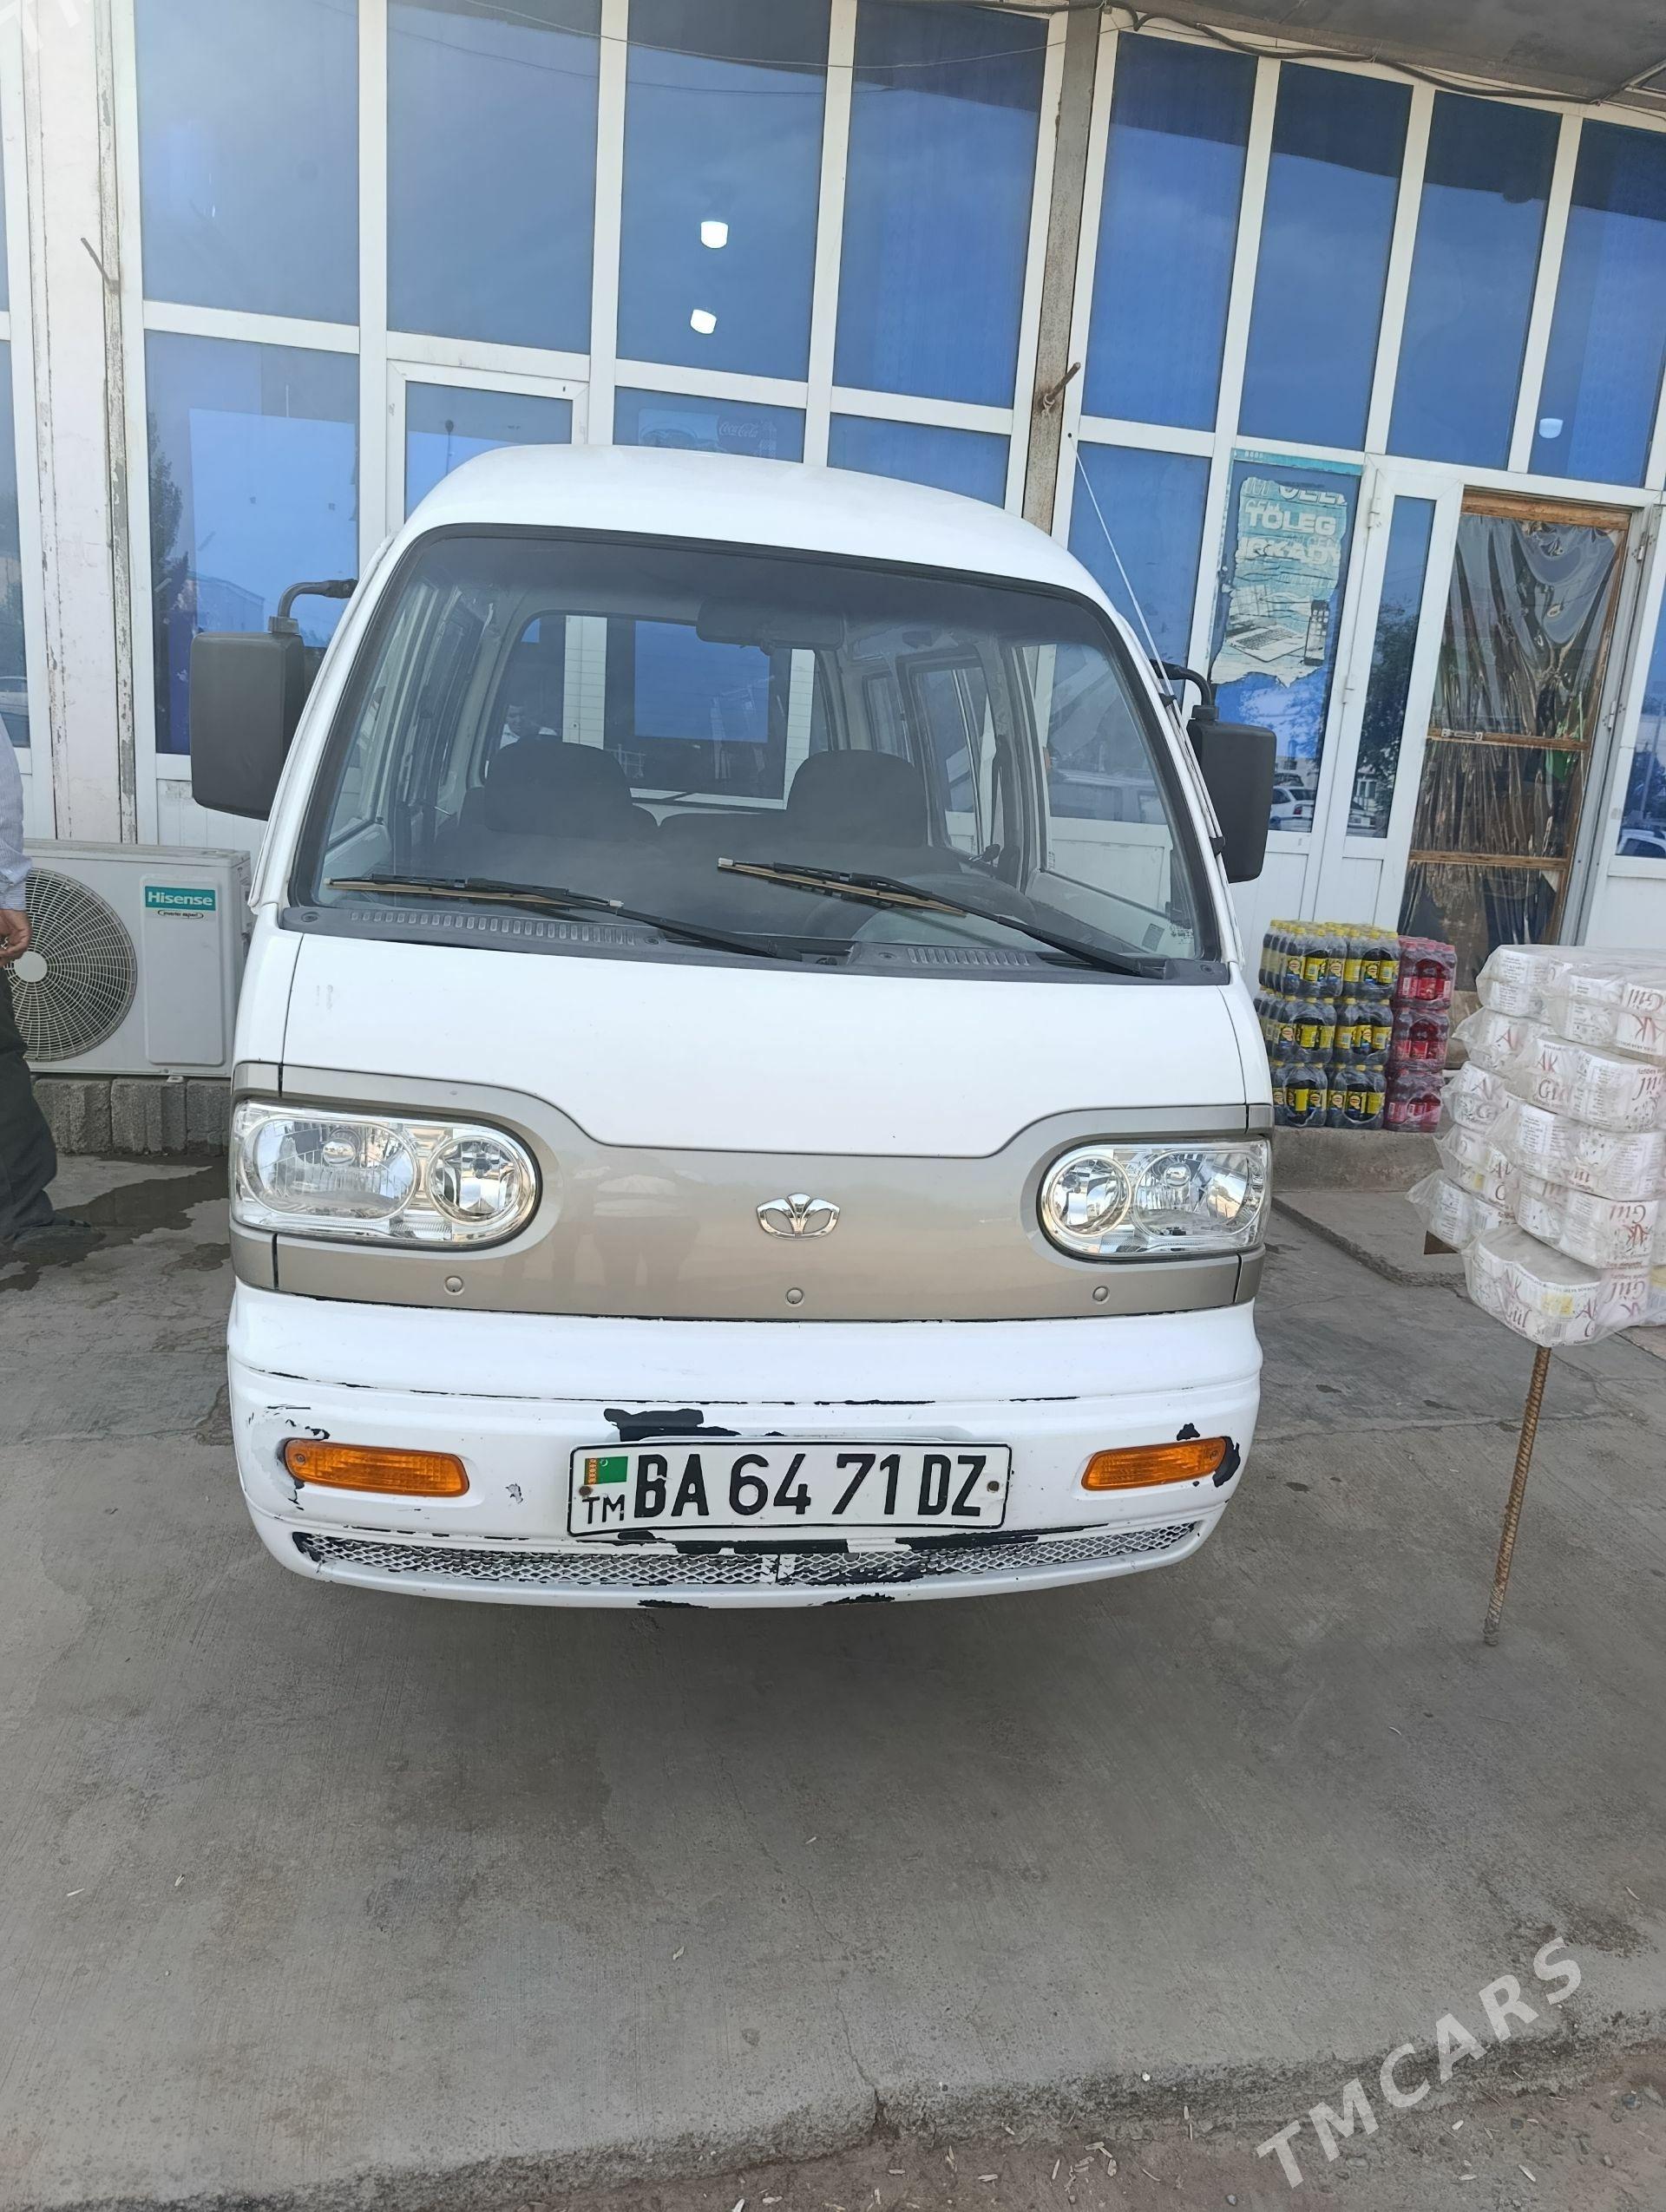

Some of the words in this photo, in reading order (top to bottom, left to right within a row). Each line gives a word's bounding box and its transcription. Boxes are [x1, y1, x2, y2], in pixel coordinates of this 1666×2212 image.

[147, 891, 214, 906] Hisense
[633, 1454, 710, 1518] BA
[729, 1453, 812, 1515] 64
[831, 1453, 902, 1515] 71
[917, 1454, 987, 1516] DZ
[581, 1494, 626, 1524] TM
